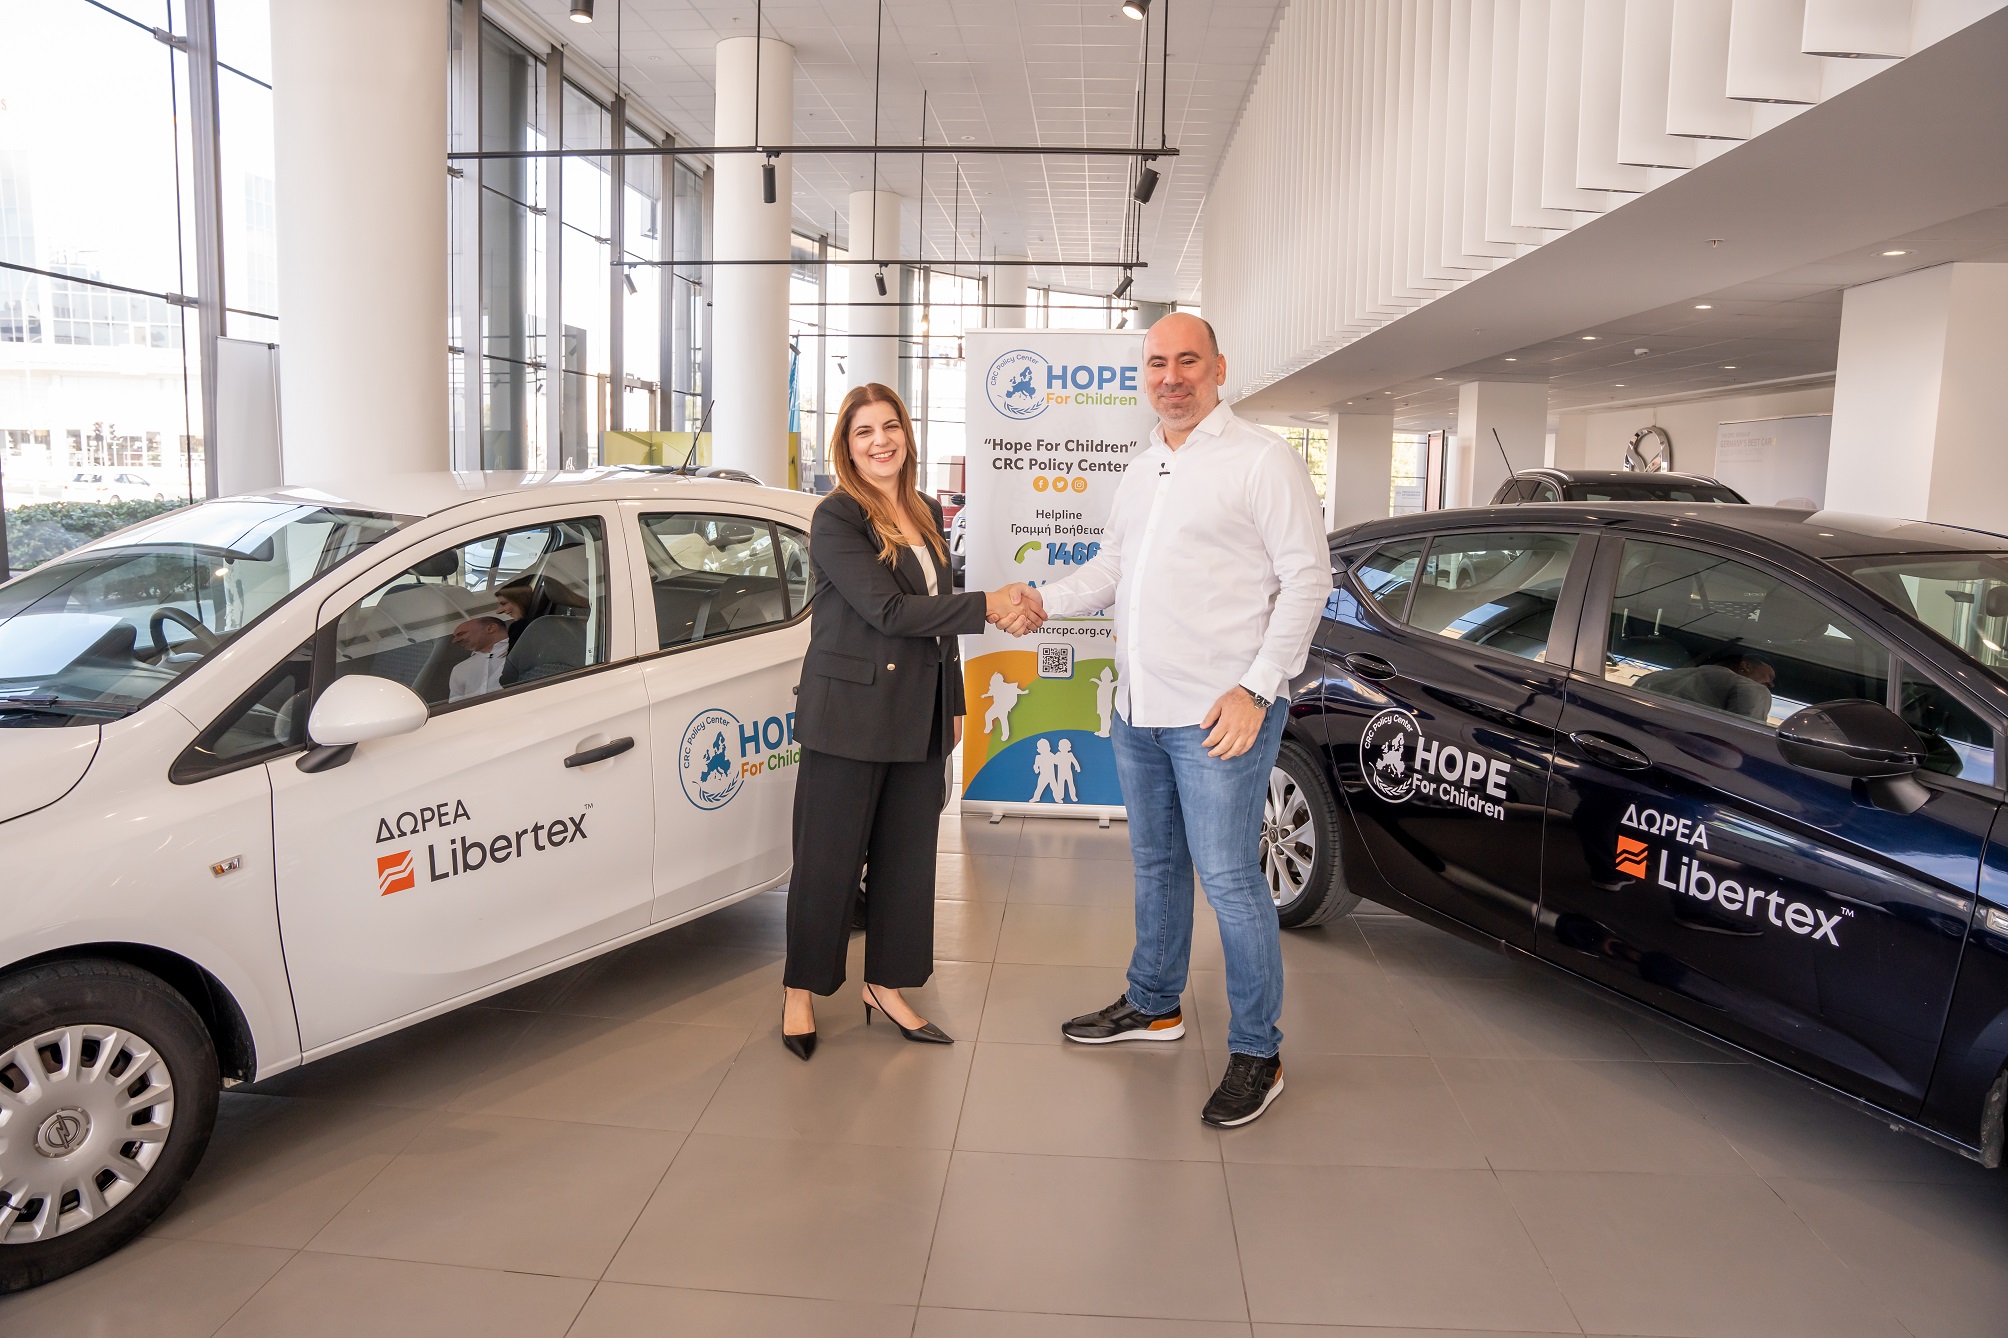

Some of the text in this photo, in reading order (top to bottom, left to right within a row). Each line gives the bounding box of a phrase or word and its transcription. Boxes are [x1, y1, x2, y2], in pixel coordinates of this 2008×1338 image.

[990, 353, 1039, 386] CRC Policy Center
[1046, 365, 1138, 391] HOPE
[1046, 392, 1138, 406] For Children
[1036, 438, 1061, 452] For
[992, 457, 1129, 475] CRC Policy Center
[1011, 523, 1051, 537] Γραμμή
[1036, 509, 1083, 521] Helpline
[683, 716, 730, 769] CRC Policy Center
[1364, 714, 1414, 749] CRC Policy Center
[741, 747, 801, 779] For Child
[1414, 736, 1511, 800] HOPE
[1412, 772, 1505, 821] For Children
[375, 799, 471, 844] ΔΩΡΕΑ
[1621, 803, 1709, 850] ΔΩΡΕΑ
[427, 812, 588, 883] Libertex
[1657, 849, 1843, 947] Libertex
